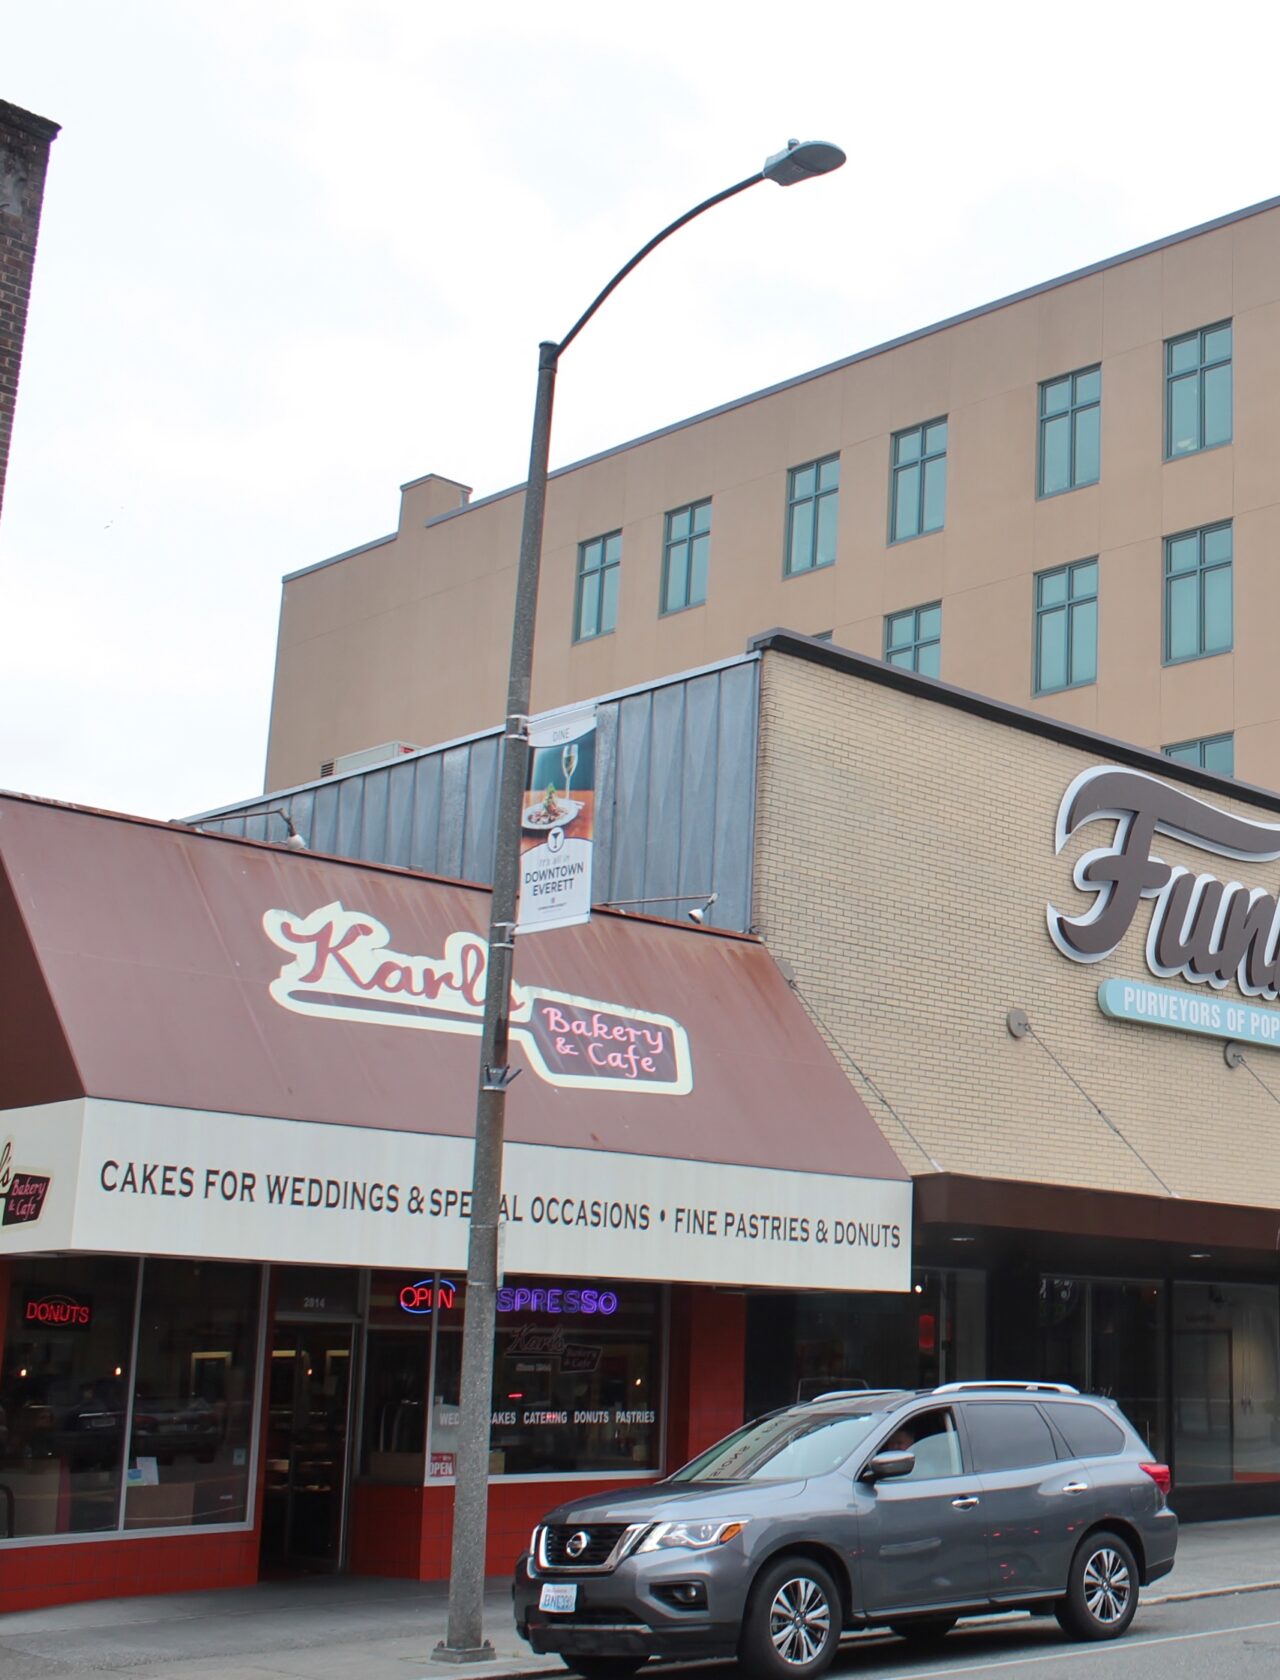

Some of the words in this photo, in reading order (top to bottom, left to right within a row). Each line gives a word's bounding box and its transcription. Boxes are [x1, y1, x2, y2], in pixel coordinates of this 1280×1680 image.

[525, 861, 584, 884] DOWNTOWN
[533, 877, 575, 896] EVERETT
[281, 920, 525, 1011] Karl
[1123, 987, 1221, 1029] PURVEYORS
[1226, 1010, 1246, 1034] OF
[1250, 1013, 1280, 1041] POP
[542, 1006, 664, 1054] Bakery
[555, 1036, 579, 1055] &
[588, 1041, 656, 1078] Cafe
[11, 1176, 46, 1200] Bakery
[100, 1159, 194, 1199] CAKES
[204, 1169, 256, 1203] FOR
[266, 1174, 399, 1213] WEDDINGS
[407, 1186, 425, 1216] &
[429, 1188, 524, 1222] SPEAL
[530, 1196, 650, 1231] OCCASIONS
[674, 1208, 718, 1236] FINE
[723, 1212, 810, 1243] PASTRIES
[815, 1220, 829, 1244] &
[834, 1220, 901, 1249] DONUTS
[25, 1301, 91, 1324] DONUTS
[401, 1286, 453, 1309] OPN
[497, 1287, 618, 1316] SPRESSO
[491, 1411, 517, 1425] AKES
[523, 1411, 568, 1424] CATERING
[574, 1411, 609, 1423] DONUTS
[615, 1411, 655, 1424] PASTRIES
